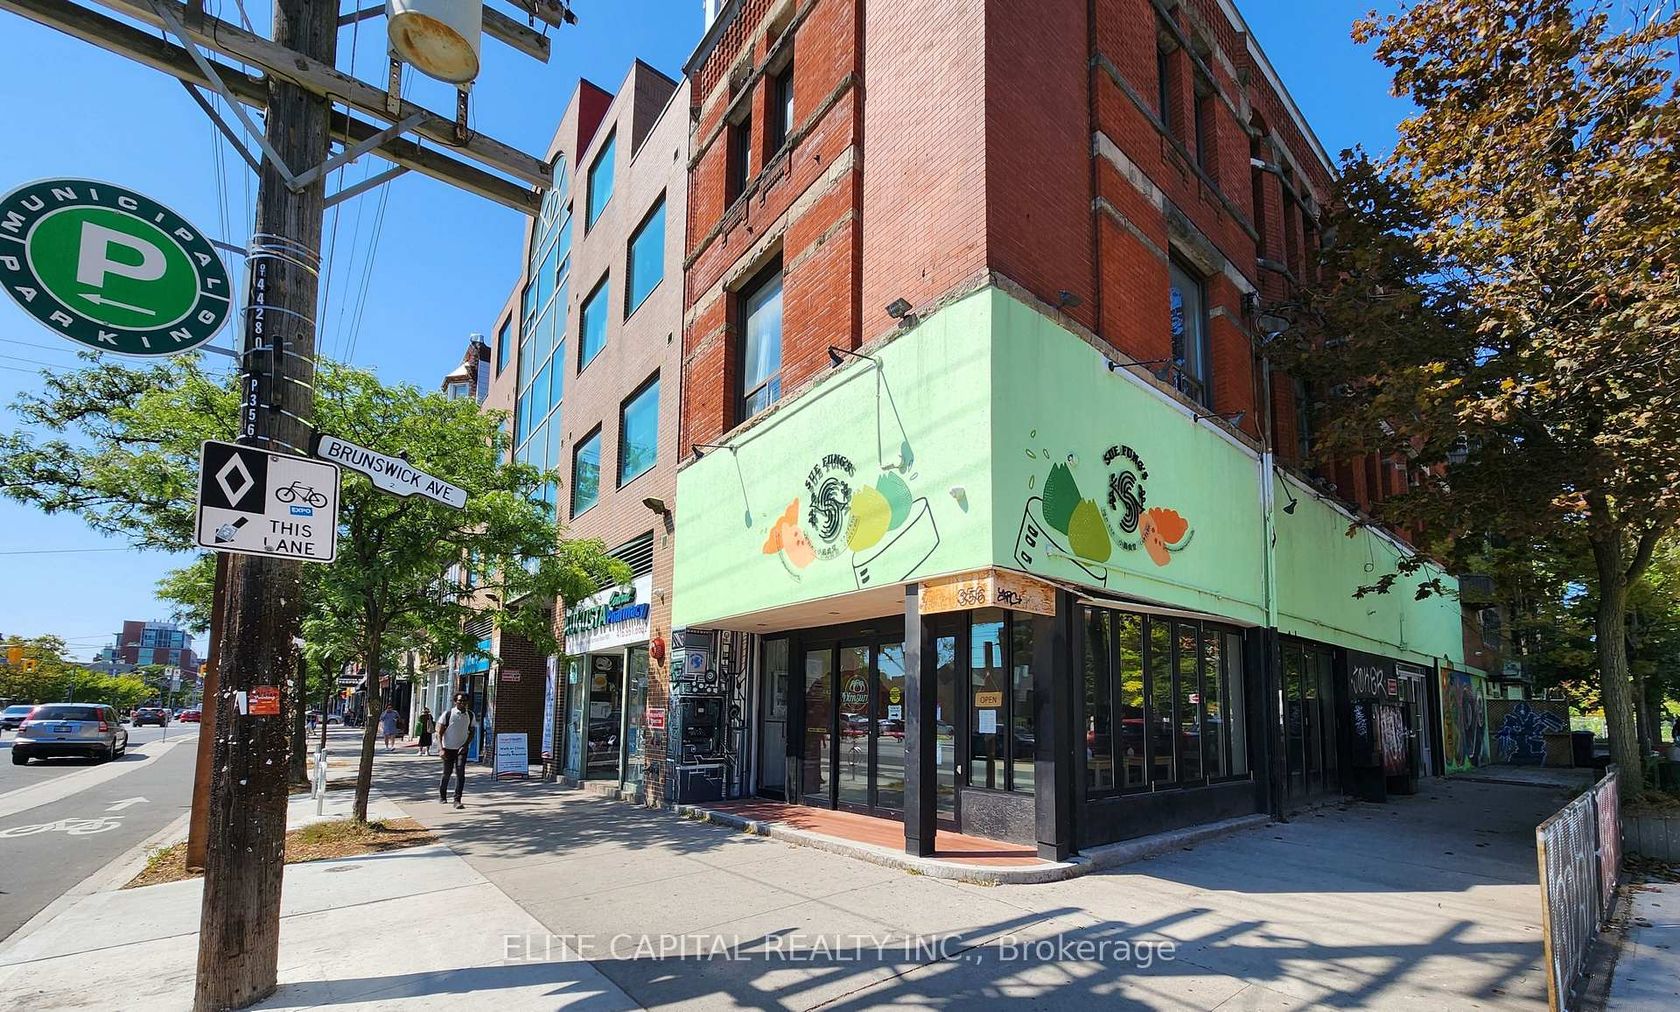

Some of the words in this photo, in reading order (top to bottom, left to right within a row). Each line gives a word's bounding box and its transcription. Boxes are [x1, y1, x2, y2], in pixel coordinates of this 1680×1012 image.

[1, 186, 221, 289] MUNICIPAL
[76, 220, 167, 288] P
[0, 255, 216, 349] PARKING
[247, 379, 258, 436] P356
[328, 441, 421, 487] BRUNSWICK
[425, 480, 454, 503] AVE.
[1103, 445, 1120, 466] SUE
[270, 519, 312, 538] THIS
[980, 695, 997, 704] OPEN
